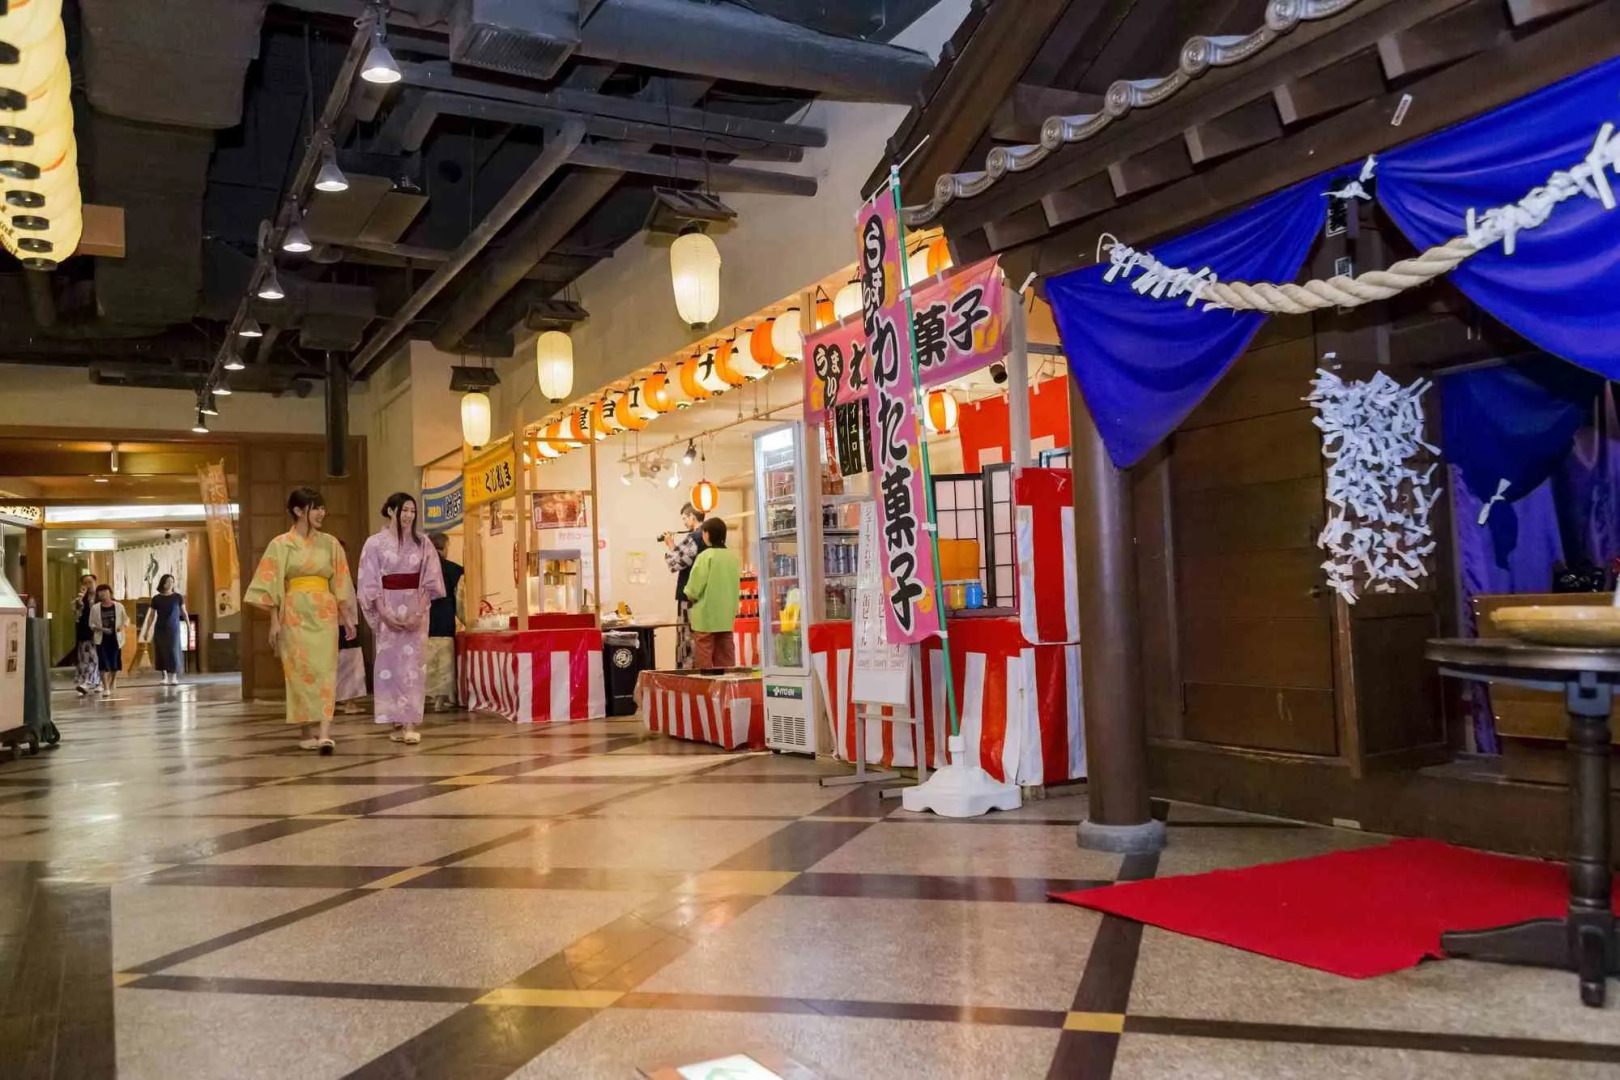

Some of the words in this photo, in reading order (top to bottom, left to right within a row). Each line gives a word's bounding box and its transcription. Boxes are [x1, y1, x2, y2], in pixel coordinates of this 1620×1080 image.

[863, 222, 882, 330] うまい
[814, 347, 841, 409] うまい
[850, 404, 859, 471] イエロー
[872, 317, 922, 631] わた菓子
